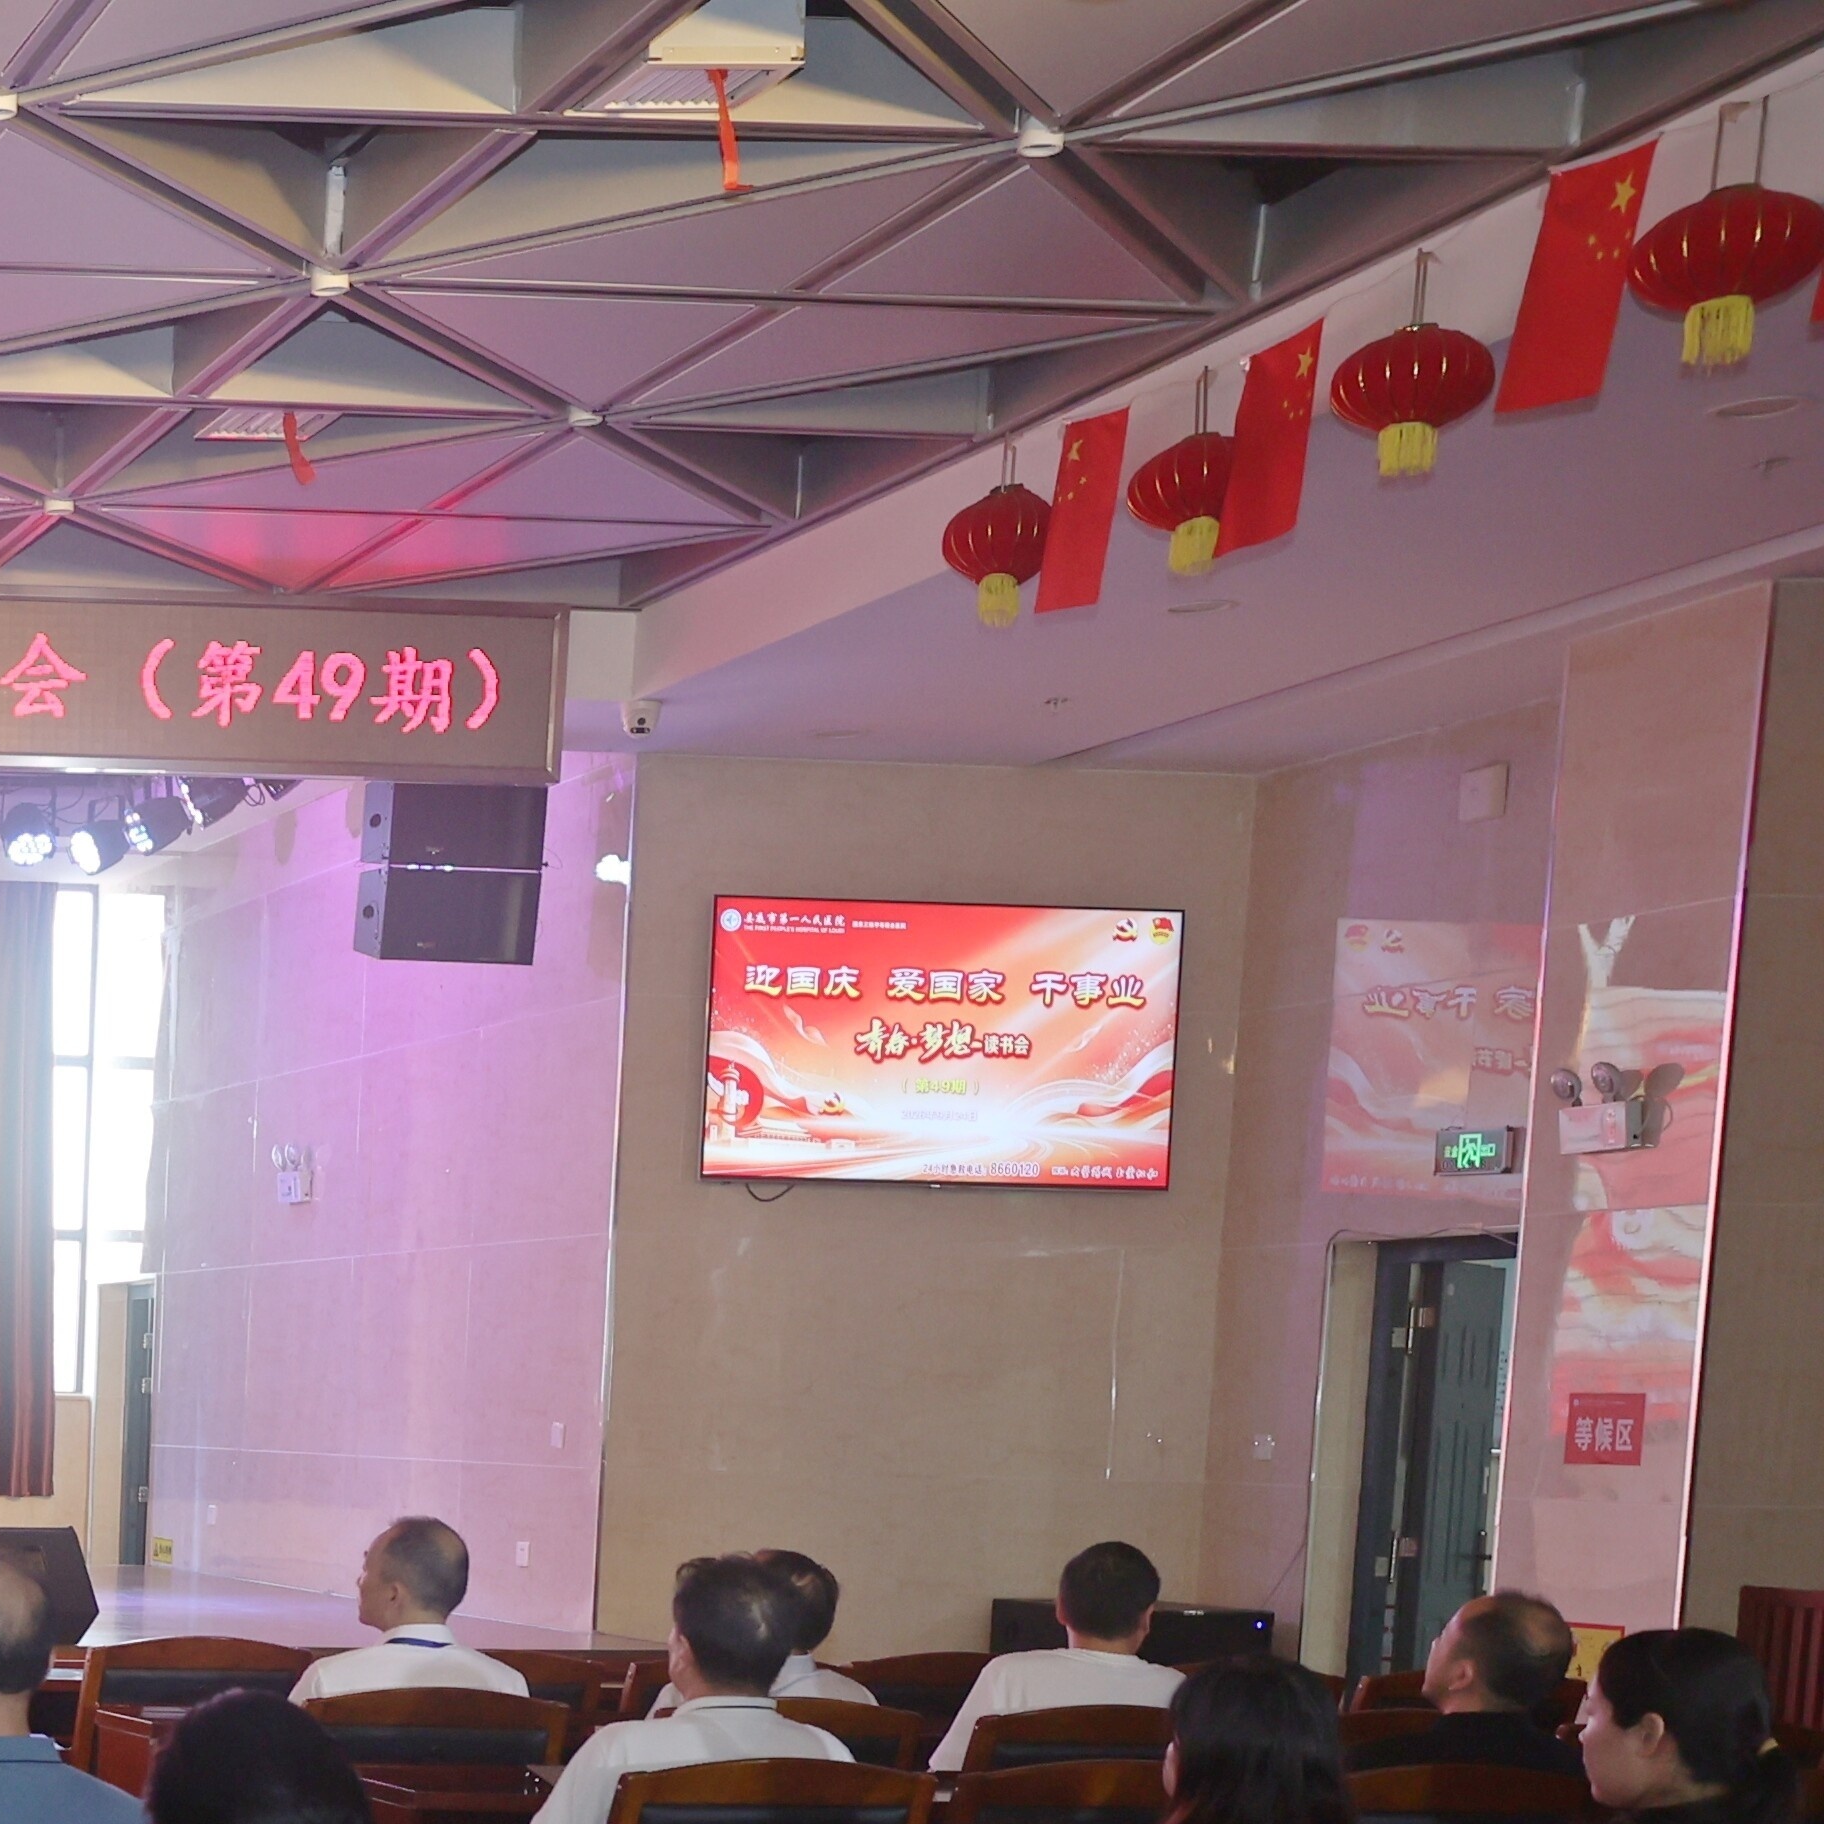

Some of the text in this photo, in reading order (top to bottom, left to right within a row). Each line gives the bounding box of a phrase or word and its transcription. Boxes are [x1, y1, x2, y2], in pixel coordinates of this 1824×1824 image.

[744, 965, 1147, 1009] 迎国庆 爱国家 干事业
[989, 1163, 1040, 1178] 8660120
[1575, 1416, 1634, 1452] 等候区
